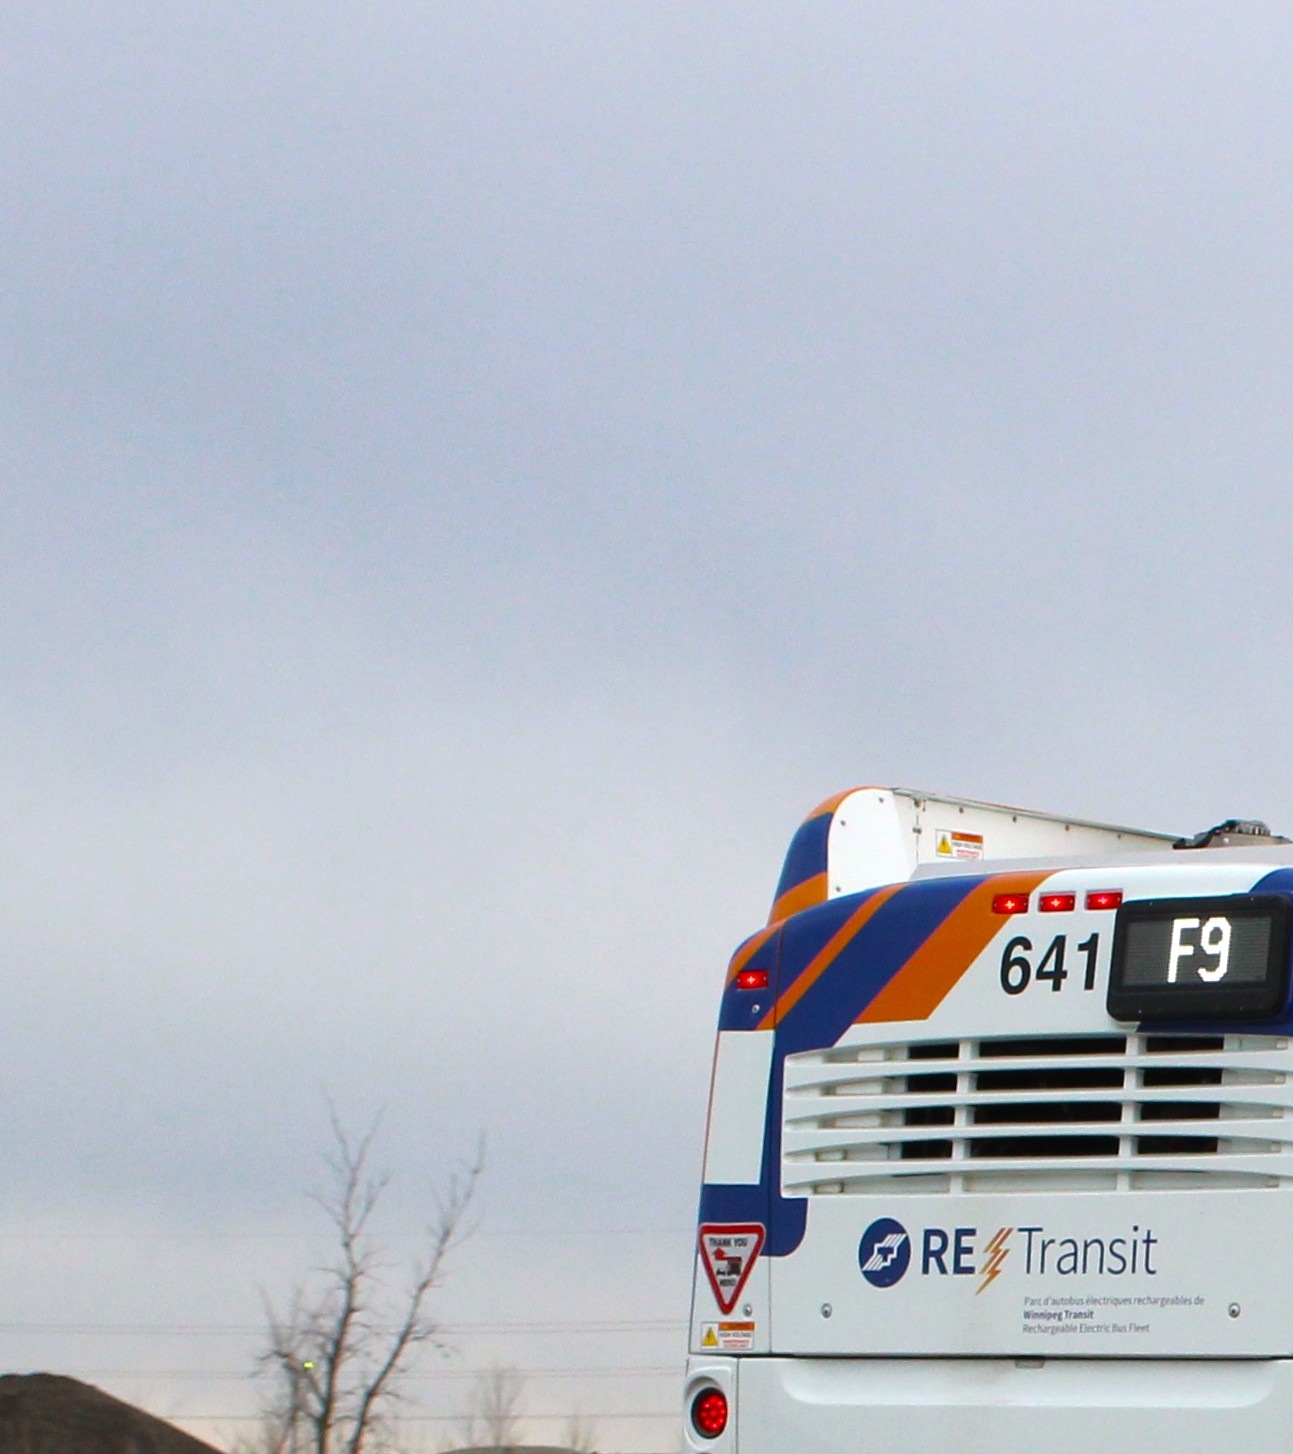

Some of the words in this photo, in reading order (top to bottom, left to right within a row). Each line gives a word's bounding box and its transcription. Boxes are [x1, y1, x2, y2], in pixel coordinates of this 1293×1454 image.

[1166, 915, 1232, 984] F9
[999, 932, 1100, 995] 641
[709, 1238, 732, 1248] THANK
[733, 1238, 748, 1248] YOU
[921, 1227, 977, 1276] RE
[1017, 1224, 1159, 1276] Transit
[1024, 1296, 1042, 1306] Parc
[1043, 1295, 1083, 1306] d'autobus
[1133, 1294, 1192, 1308] rechargeables
[1193, 1295, 1205, 1306] de
[1023, 1309, 1063, 1321] Winnipeg
[1064, 1308, 1095, 1320] Transit
[1022, 1323, 1078, 1336] Rechargeable
[1079, 1322, 1110, 1333] Electric
[1111, 1322, 1127, 1333] Bus
[1128, 1321, 1150, 1332] Fleet
